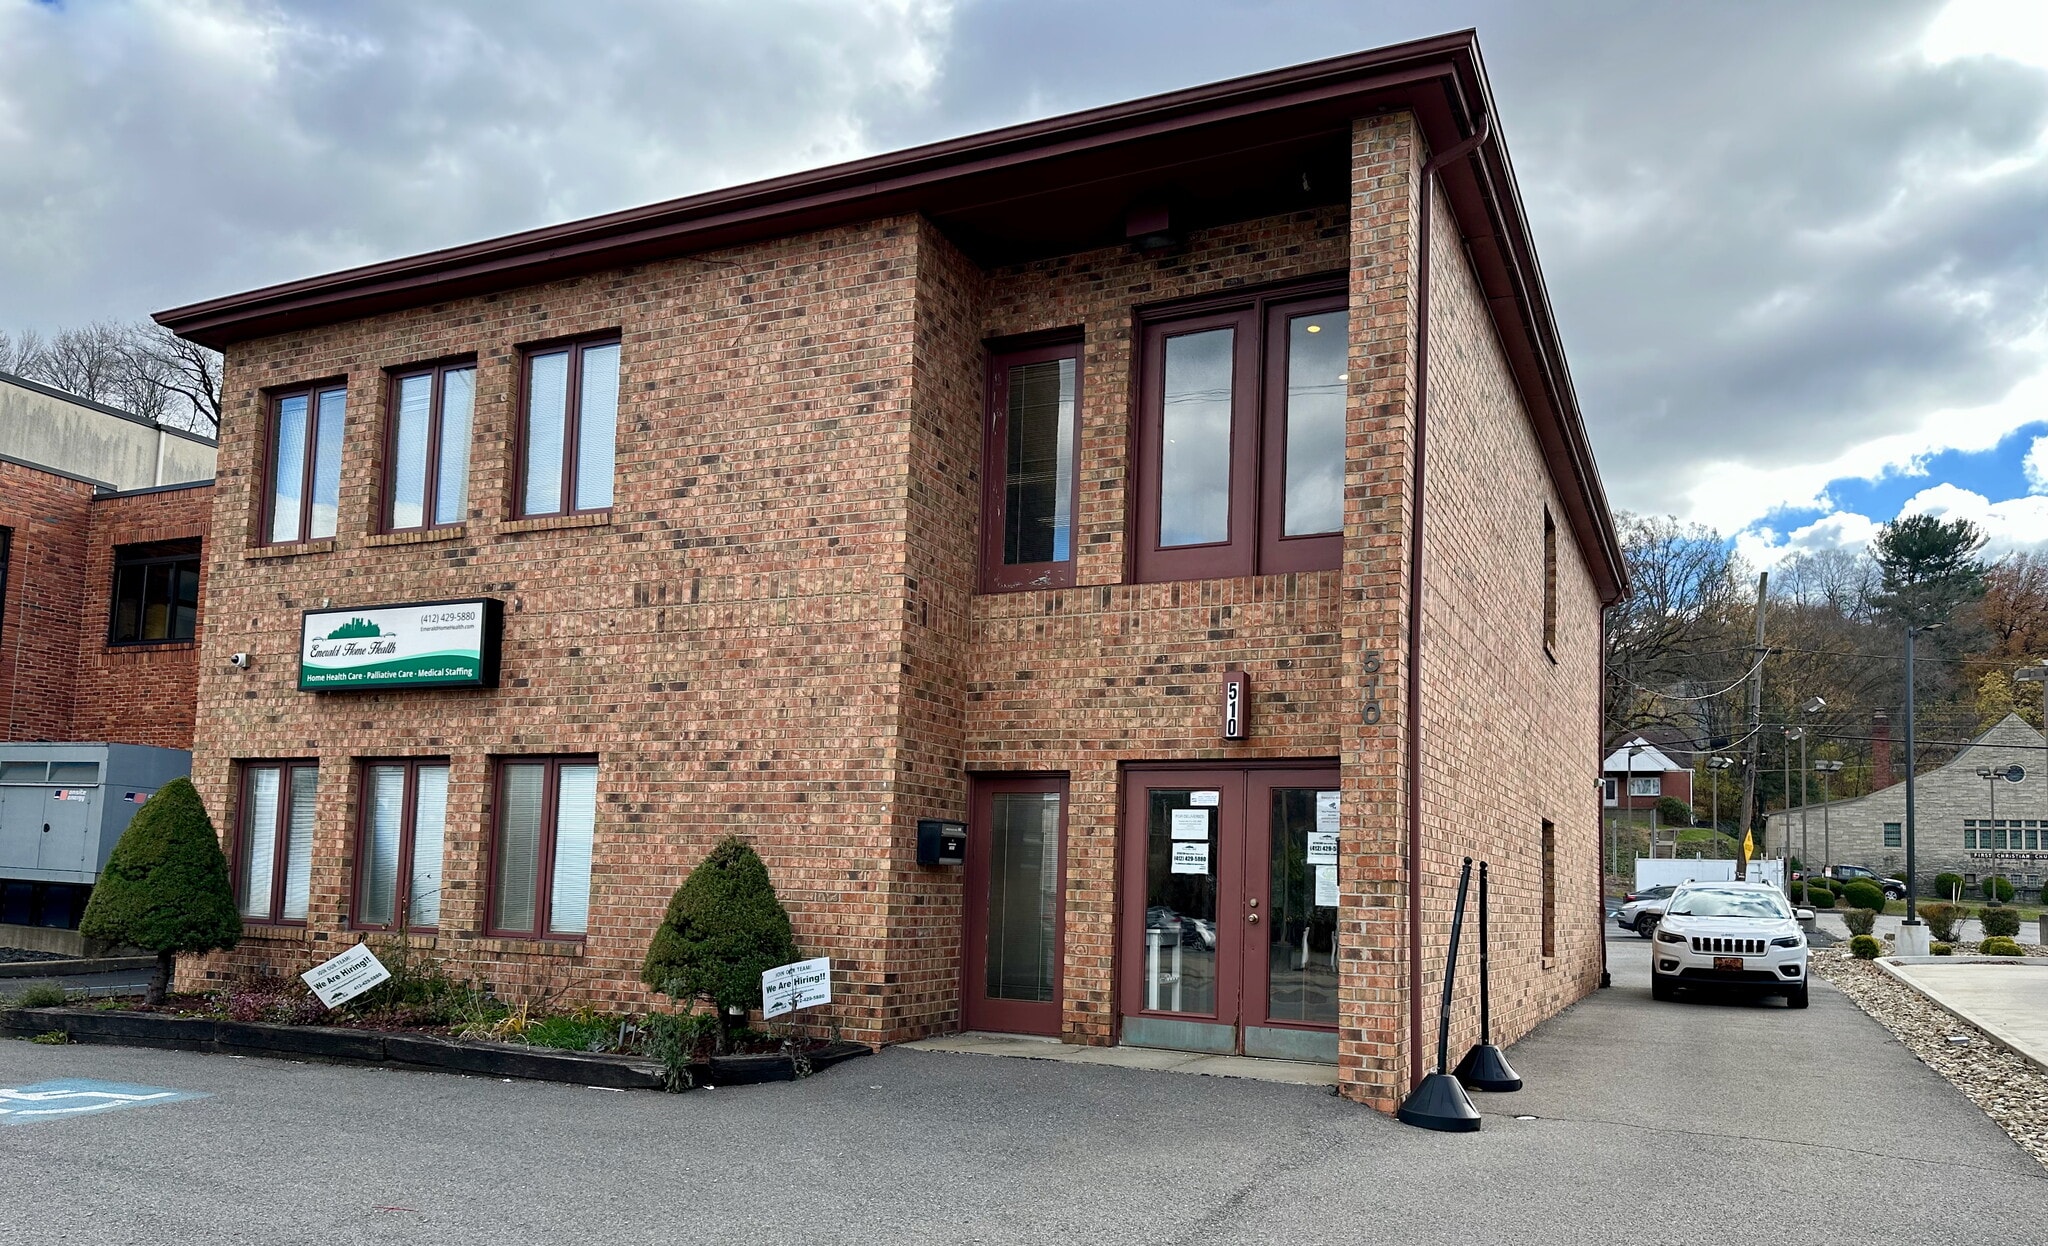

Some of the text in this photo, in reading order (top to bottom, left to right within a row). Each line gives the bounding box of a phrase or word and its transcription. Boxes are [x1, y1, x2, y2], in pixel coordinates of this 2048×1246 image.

[420, 611, 476, 625] (412) 429-5880
[310, 640, 396, 658] Emerald Home Health
[306, 667, 473, 682] Home Health Care Palliative Care Medical Staffing
[1362, 650, 1381, 725] 510
[1227, 682, 1238, 736] 510
[313, 980, 327, 990] We
[327, 973, 341, 985] Are
[340, 956, 372, 977] Hiring!!
[766, 985, 777, 994] We
[778, 981, 792, 990] Are
[793, 972, 826, 987] Hiring!!
